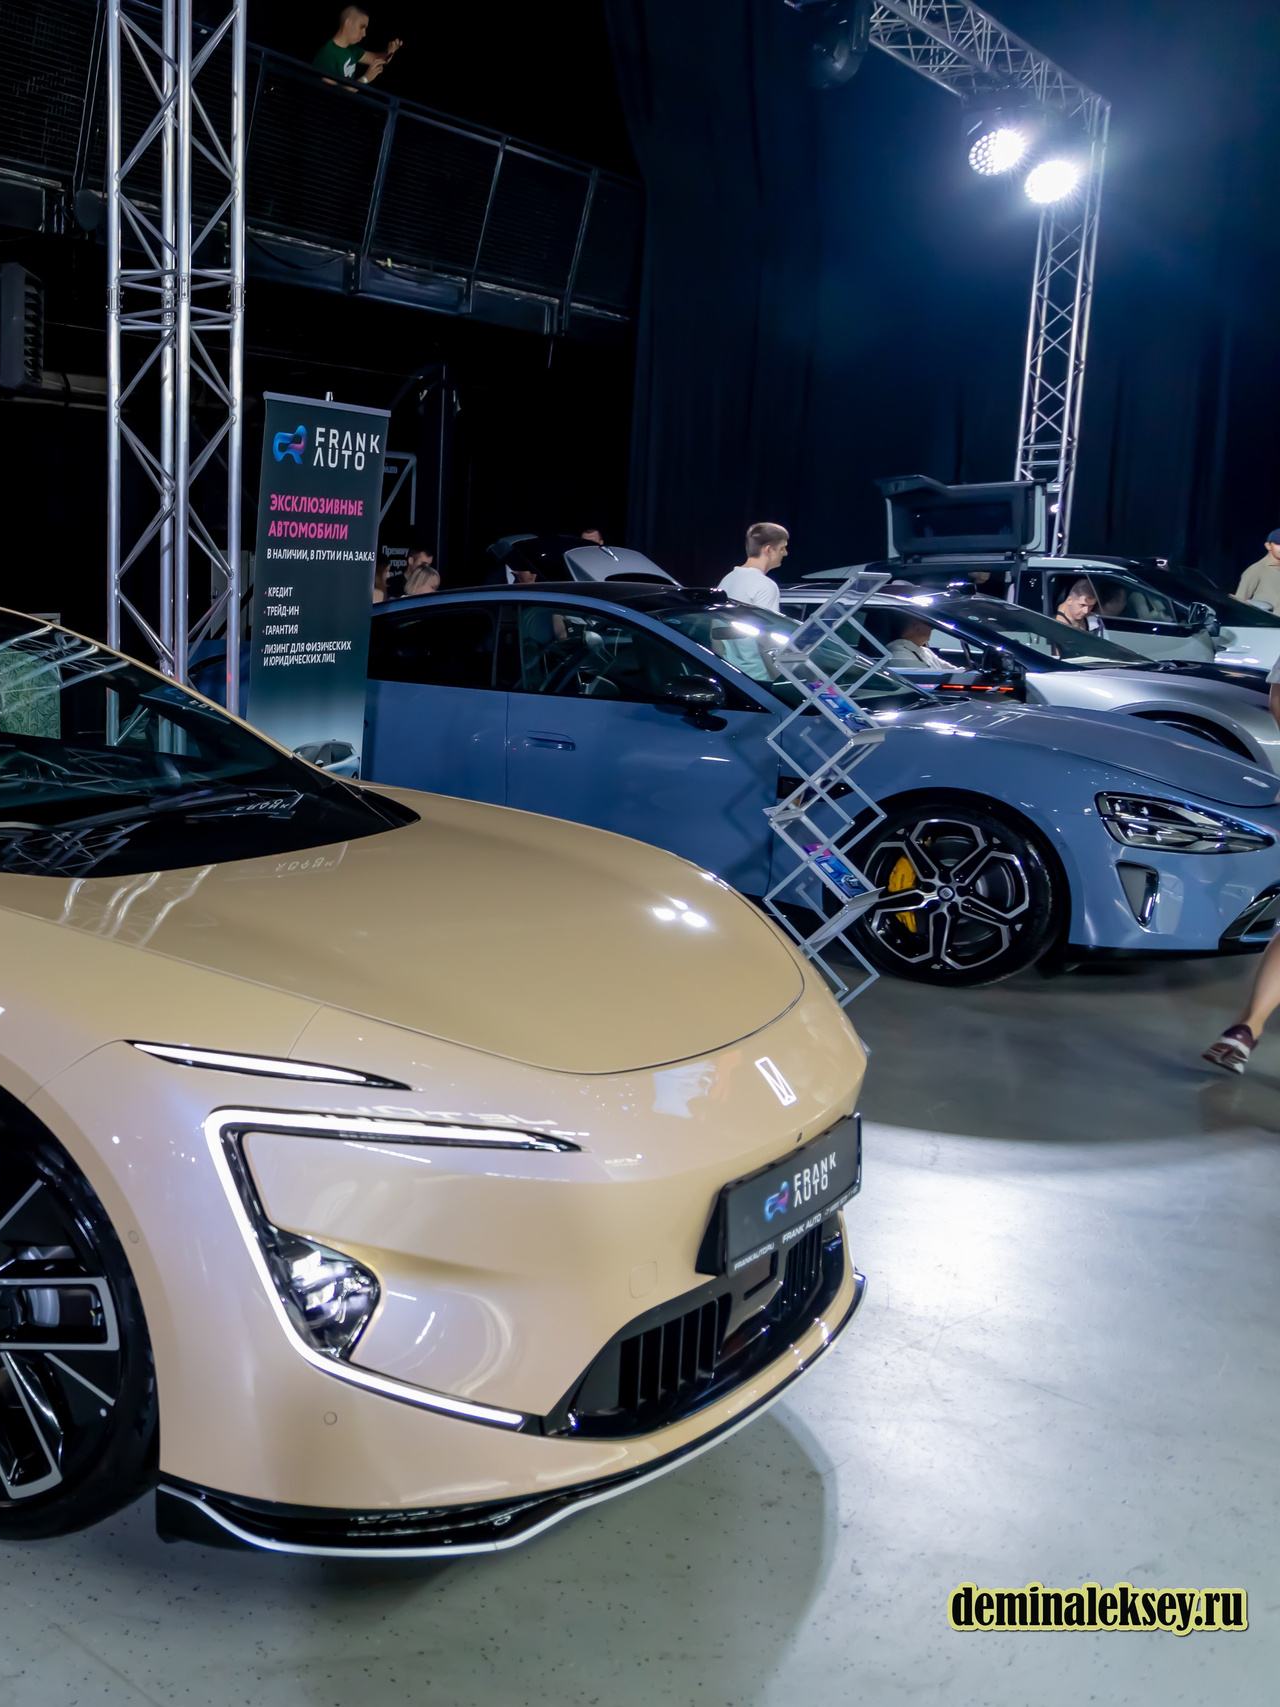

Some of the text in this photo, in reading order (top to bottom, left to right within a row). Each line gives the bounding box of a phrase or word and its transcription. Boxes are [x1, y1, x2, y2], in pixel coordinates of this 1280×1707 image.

[315, 426, 380, 454] FRANK
[313, 446, 366, 471] AUTO
[269, 493, 364, 516] ЭКСКЛЮЗИВНЫЕ
[267, 520, 349, 540] АВТОМОБИЛИ
[266, 548, 375, 562] В НАЛИЧИИ, В ПУТИ И НА ЗАКАЗ
[267, 586, 293, 599] КРЕДИТ
[266, 603, 300, 617] ТРЕЙД-ИН
[265, 624, 299, 636] ГАРАНТИЯ
[263, 640, 352, 655] ЛИЗИНГ ДЛЯ ФИЗИЧЕСКИХ
[263, 652, 336, 667] И ЮРИДИЧЕСКИХ ЛИЦ
[793, 1151, 837, 1191] FRANK
[793, 1173, 829, 1208] AUTO
[782, 1223, 805, 1244] FRANK
[805, 1212, 822, 1230] AUTO
